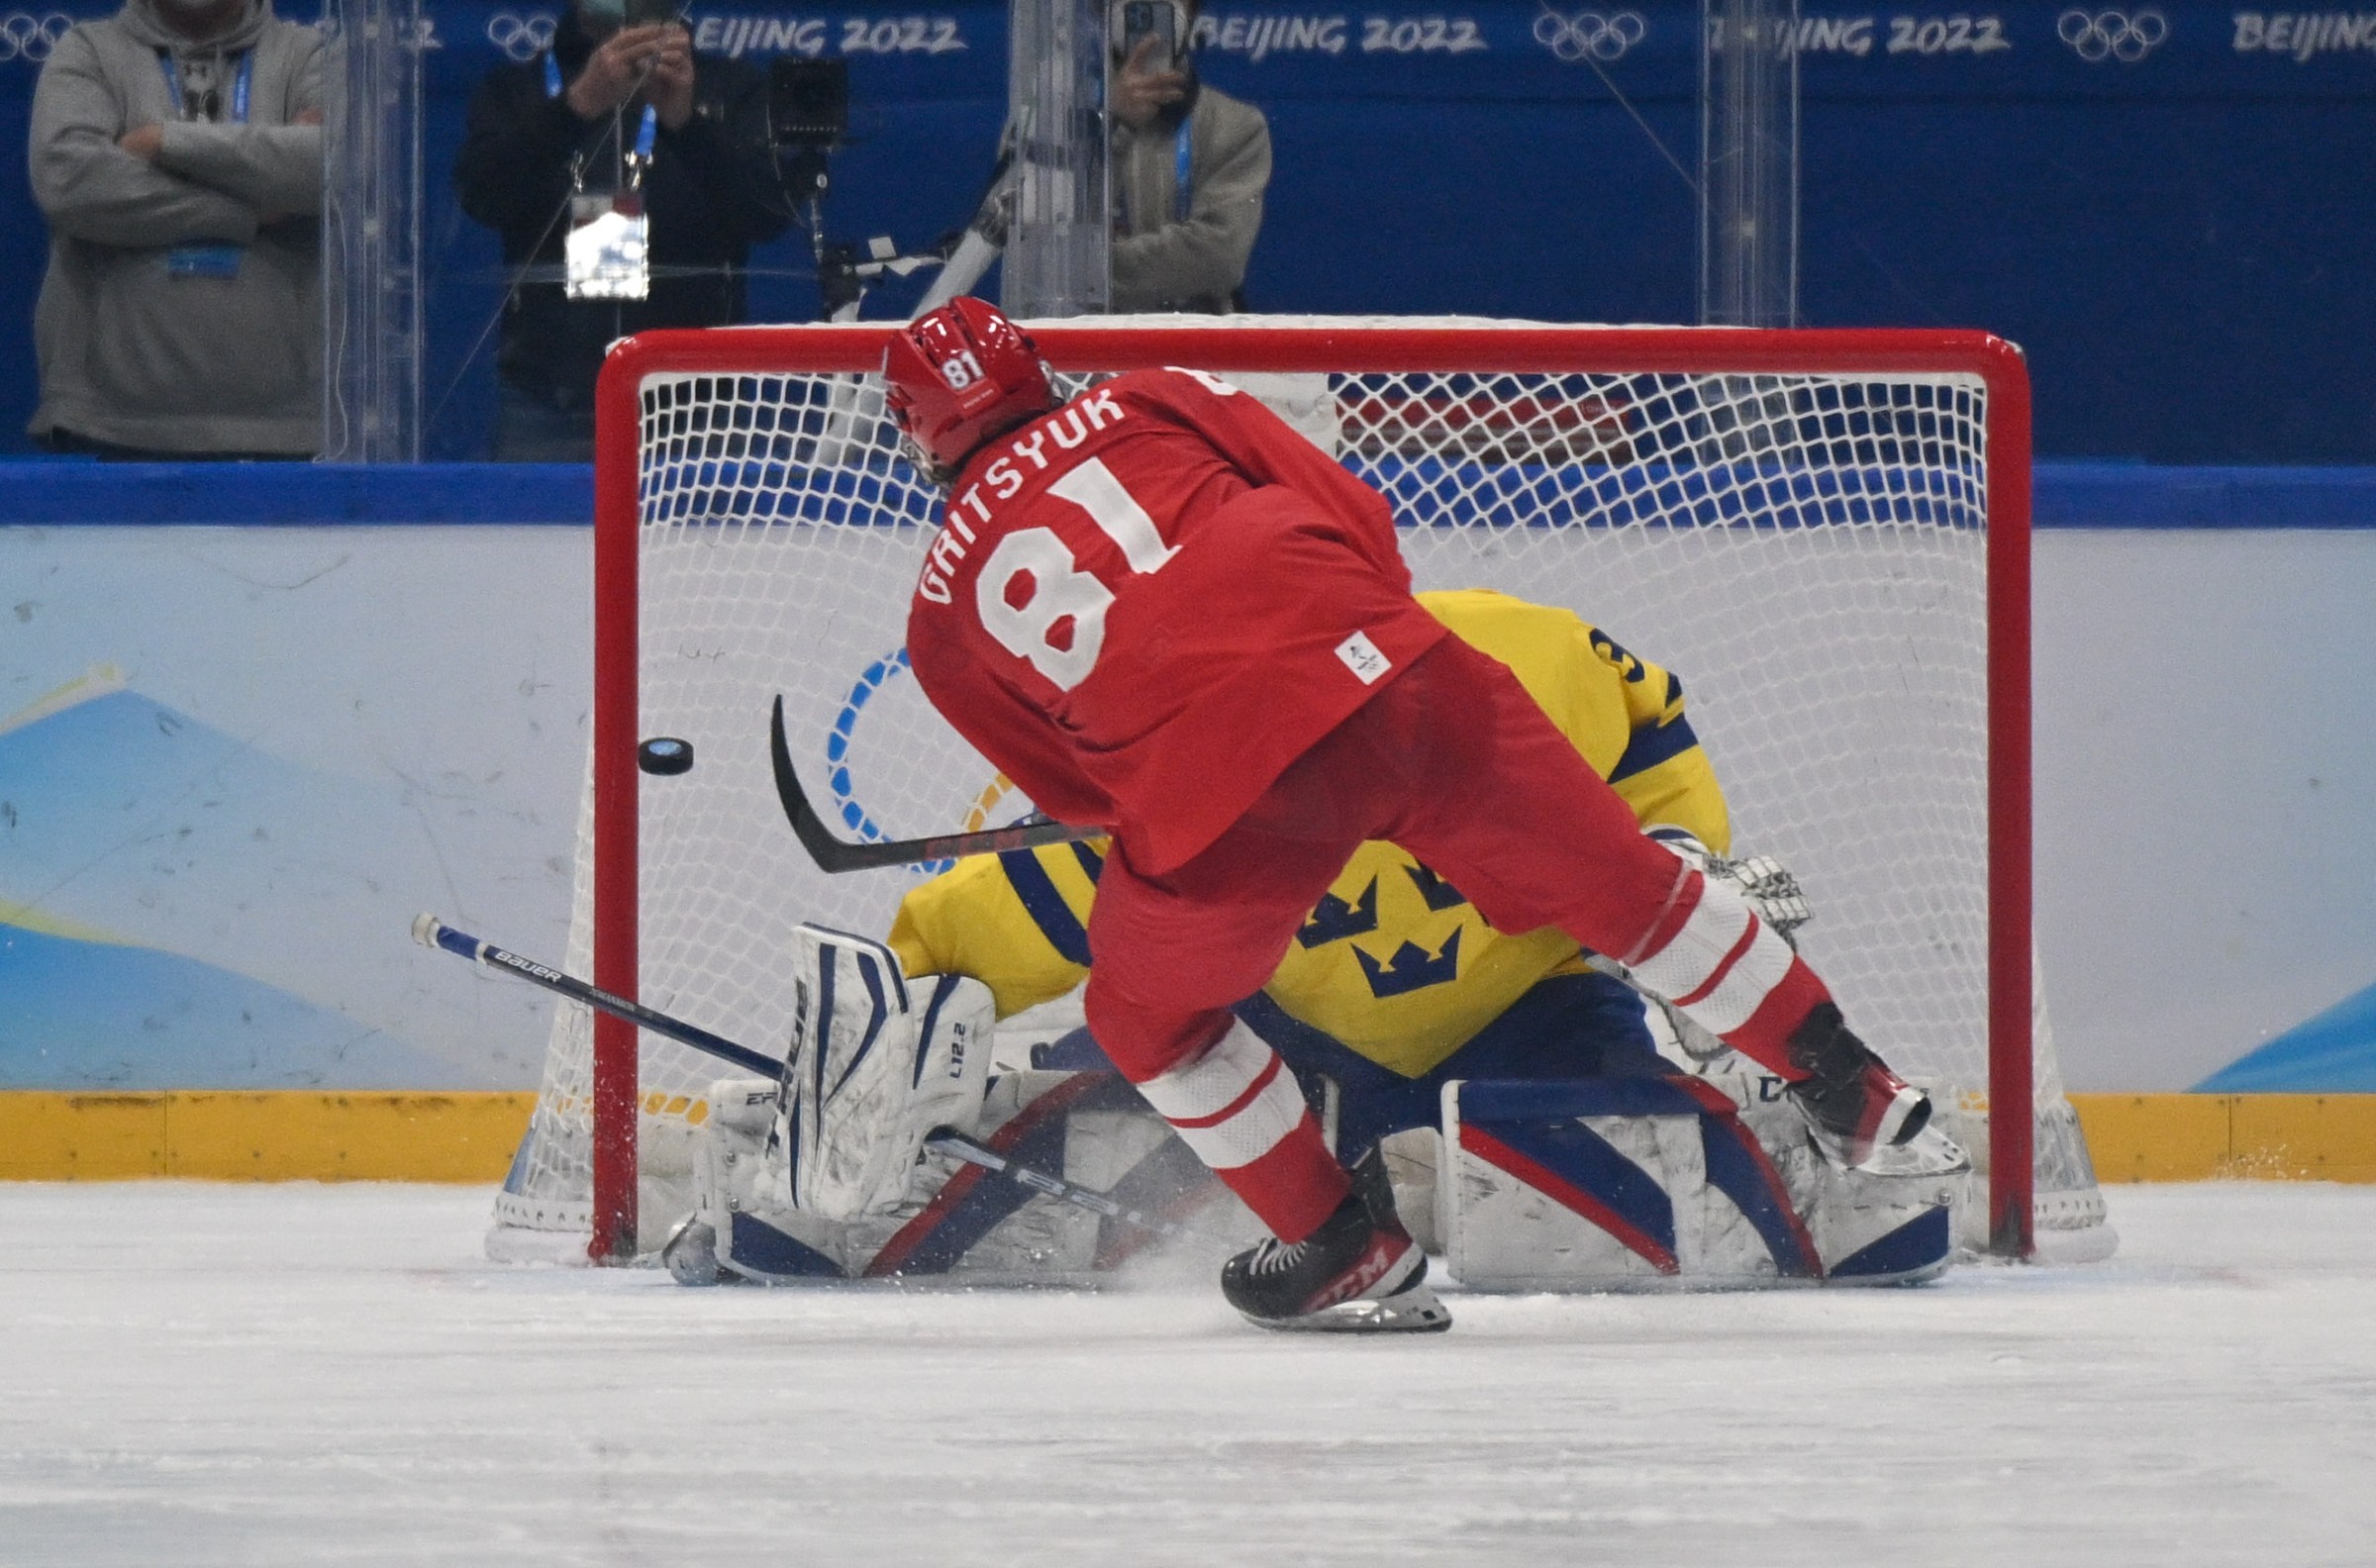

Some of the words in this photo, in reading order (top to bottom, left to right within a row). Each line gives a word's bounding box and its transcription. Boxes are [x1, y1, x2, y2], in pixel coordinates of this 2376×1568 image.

[694, 17, 827, 57] EIJING
[842, 18, 968, 52] 2022
[1189, 15, 1346, 61] BEIJING
[1362, 18, 1488, 52] 2022
[1886, 17, 2012, 53] 2022
[942, 349, 985, 389] 81
[919, 388, 1126, 605] GRITSYUK
[976, 456, 1183, 693] 81
